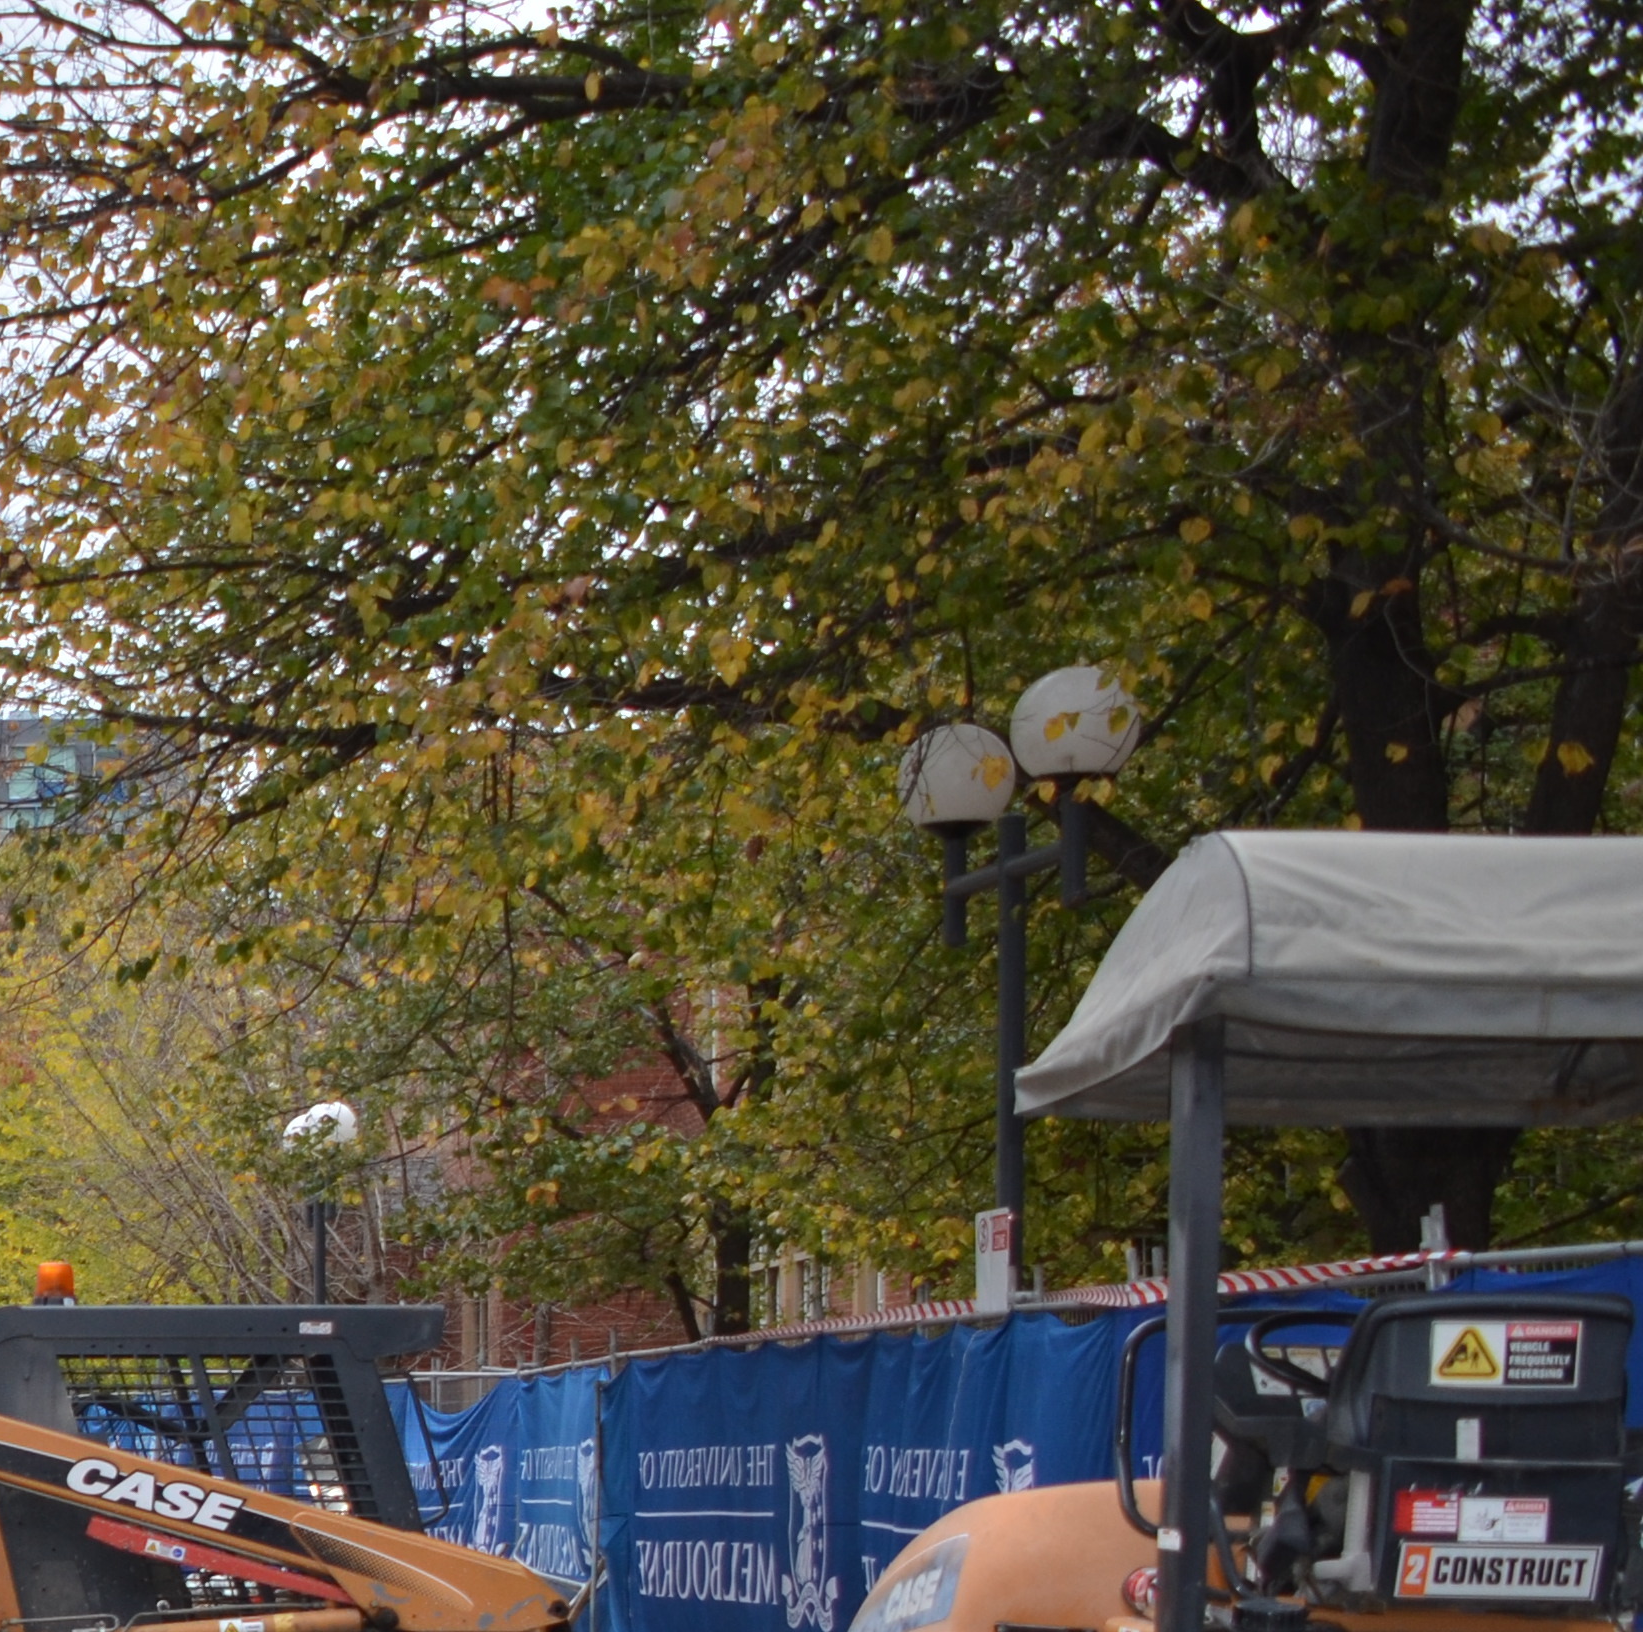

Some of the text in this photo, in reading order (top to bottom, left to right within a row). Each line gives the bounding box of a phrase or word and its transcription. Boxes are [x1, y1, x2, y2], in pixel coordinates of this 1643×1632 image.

[1525, 1325, 1572, 1336] DANGER
[1509, 1341, 1550, 1353] VEHICLE
[1508, 1354, 1572, 1366] FREQUENTLY
[1507, 1368, 1564, 1379] REVERSING
[66, 1457, 245, 1532] CASE
[1403, 1553, 1589, 1587] 2 CONSTRUCT
[884, 1567, 944, 1625] CASE
